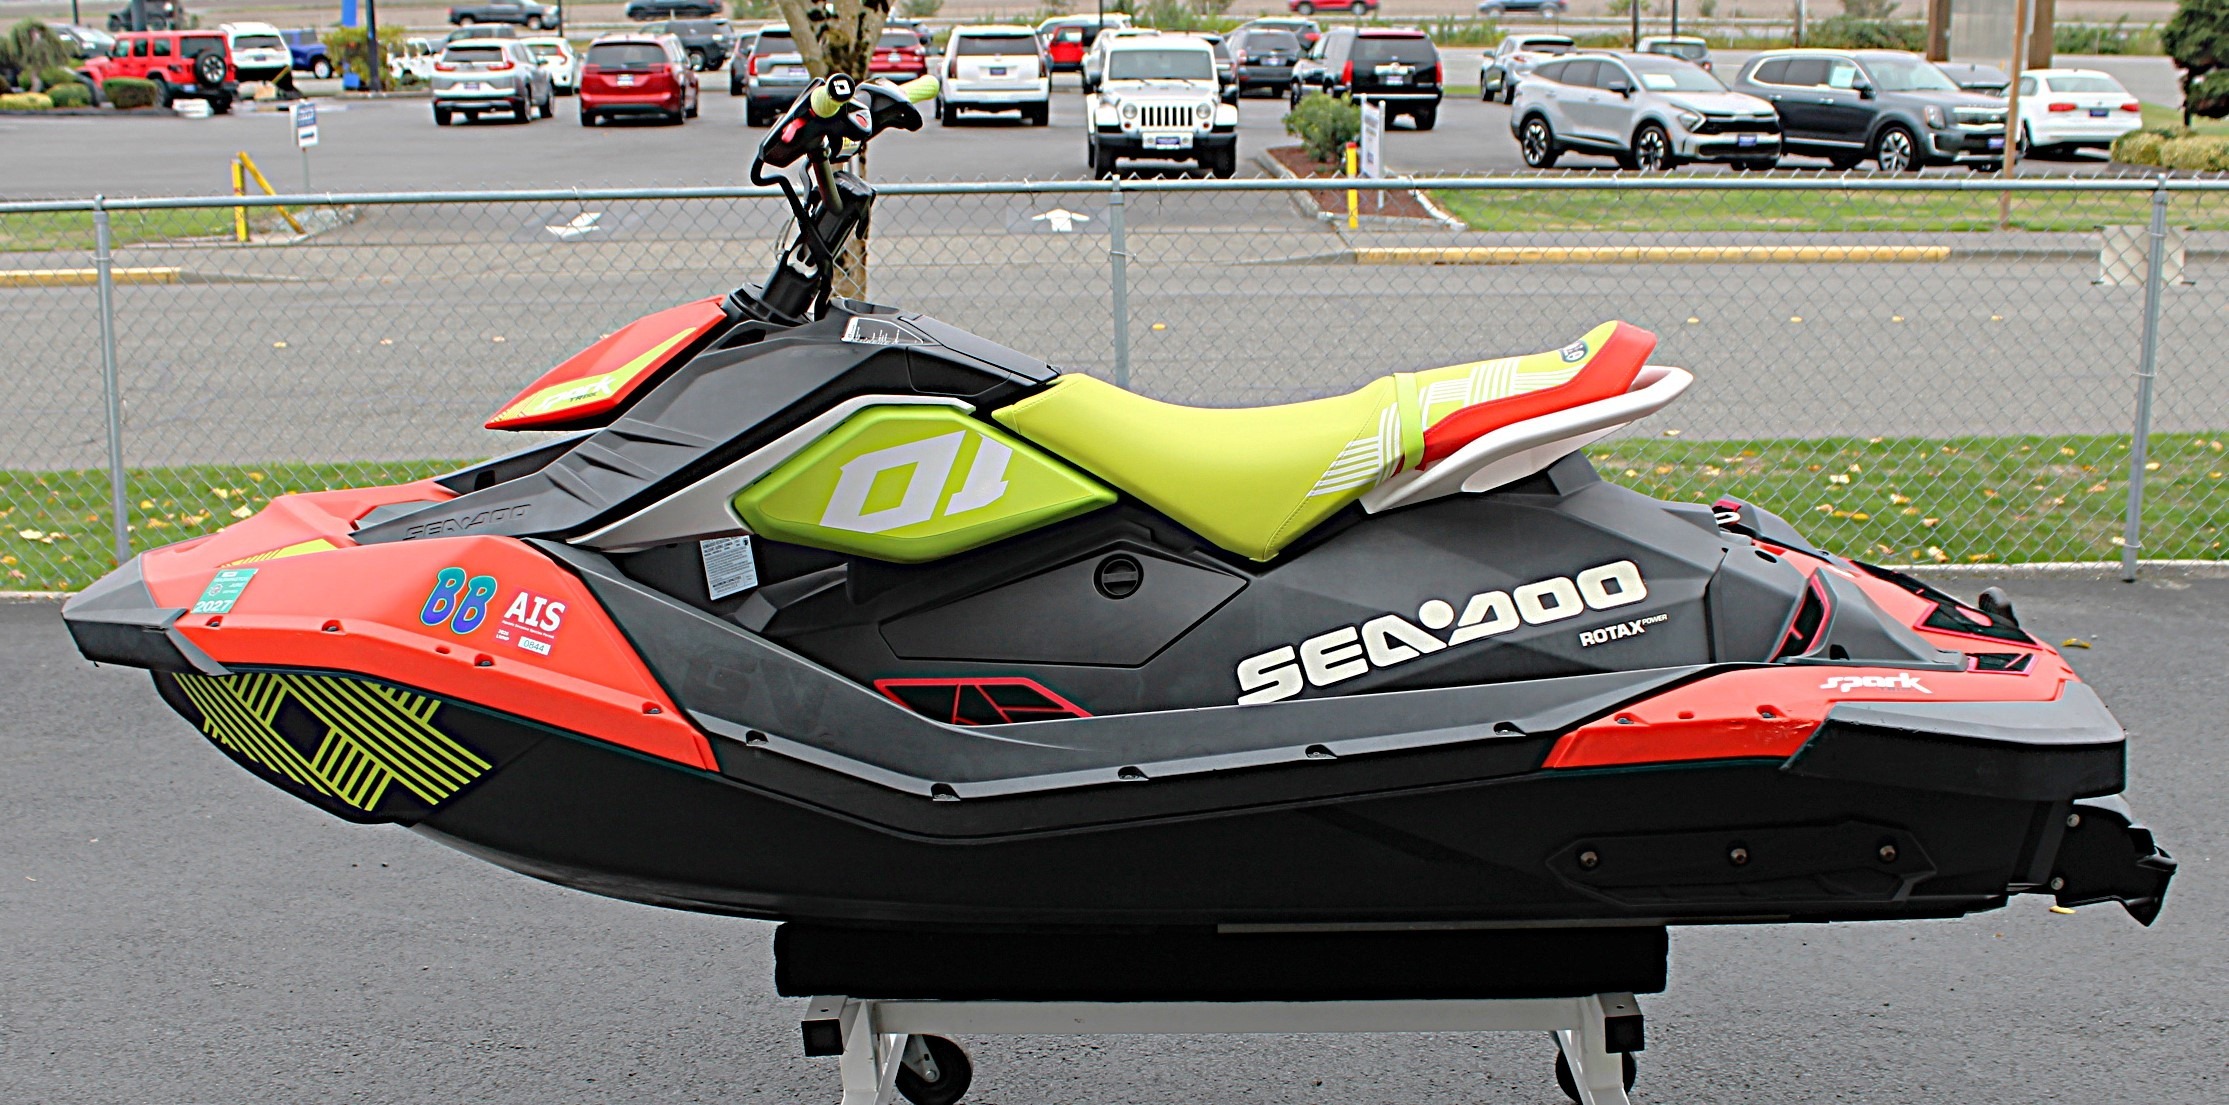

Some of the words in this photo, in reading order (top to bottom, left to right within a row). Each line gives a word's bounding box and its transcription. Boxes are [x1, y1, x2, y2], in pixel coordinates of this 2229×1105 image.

[192, 600, 234, 613] 2027
[419, 566, 498, 635] BB
[503, 591, 566, 632] AIS
[1579, 619, 1645, 647] ROTAX
[1642, 613, 1668, 626] POWER
[523, 640, 545, 652] 0844
[1819, 672, 1933, 694] spark
